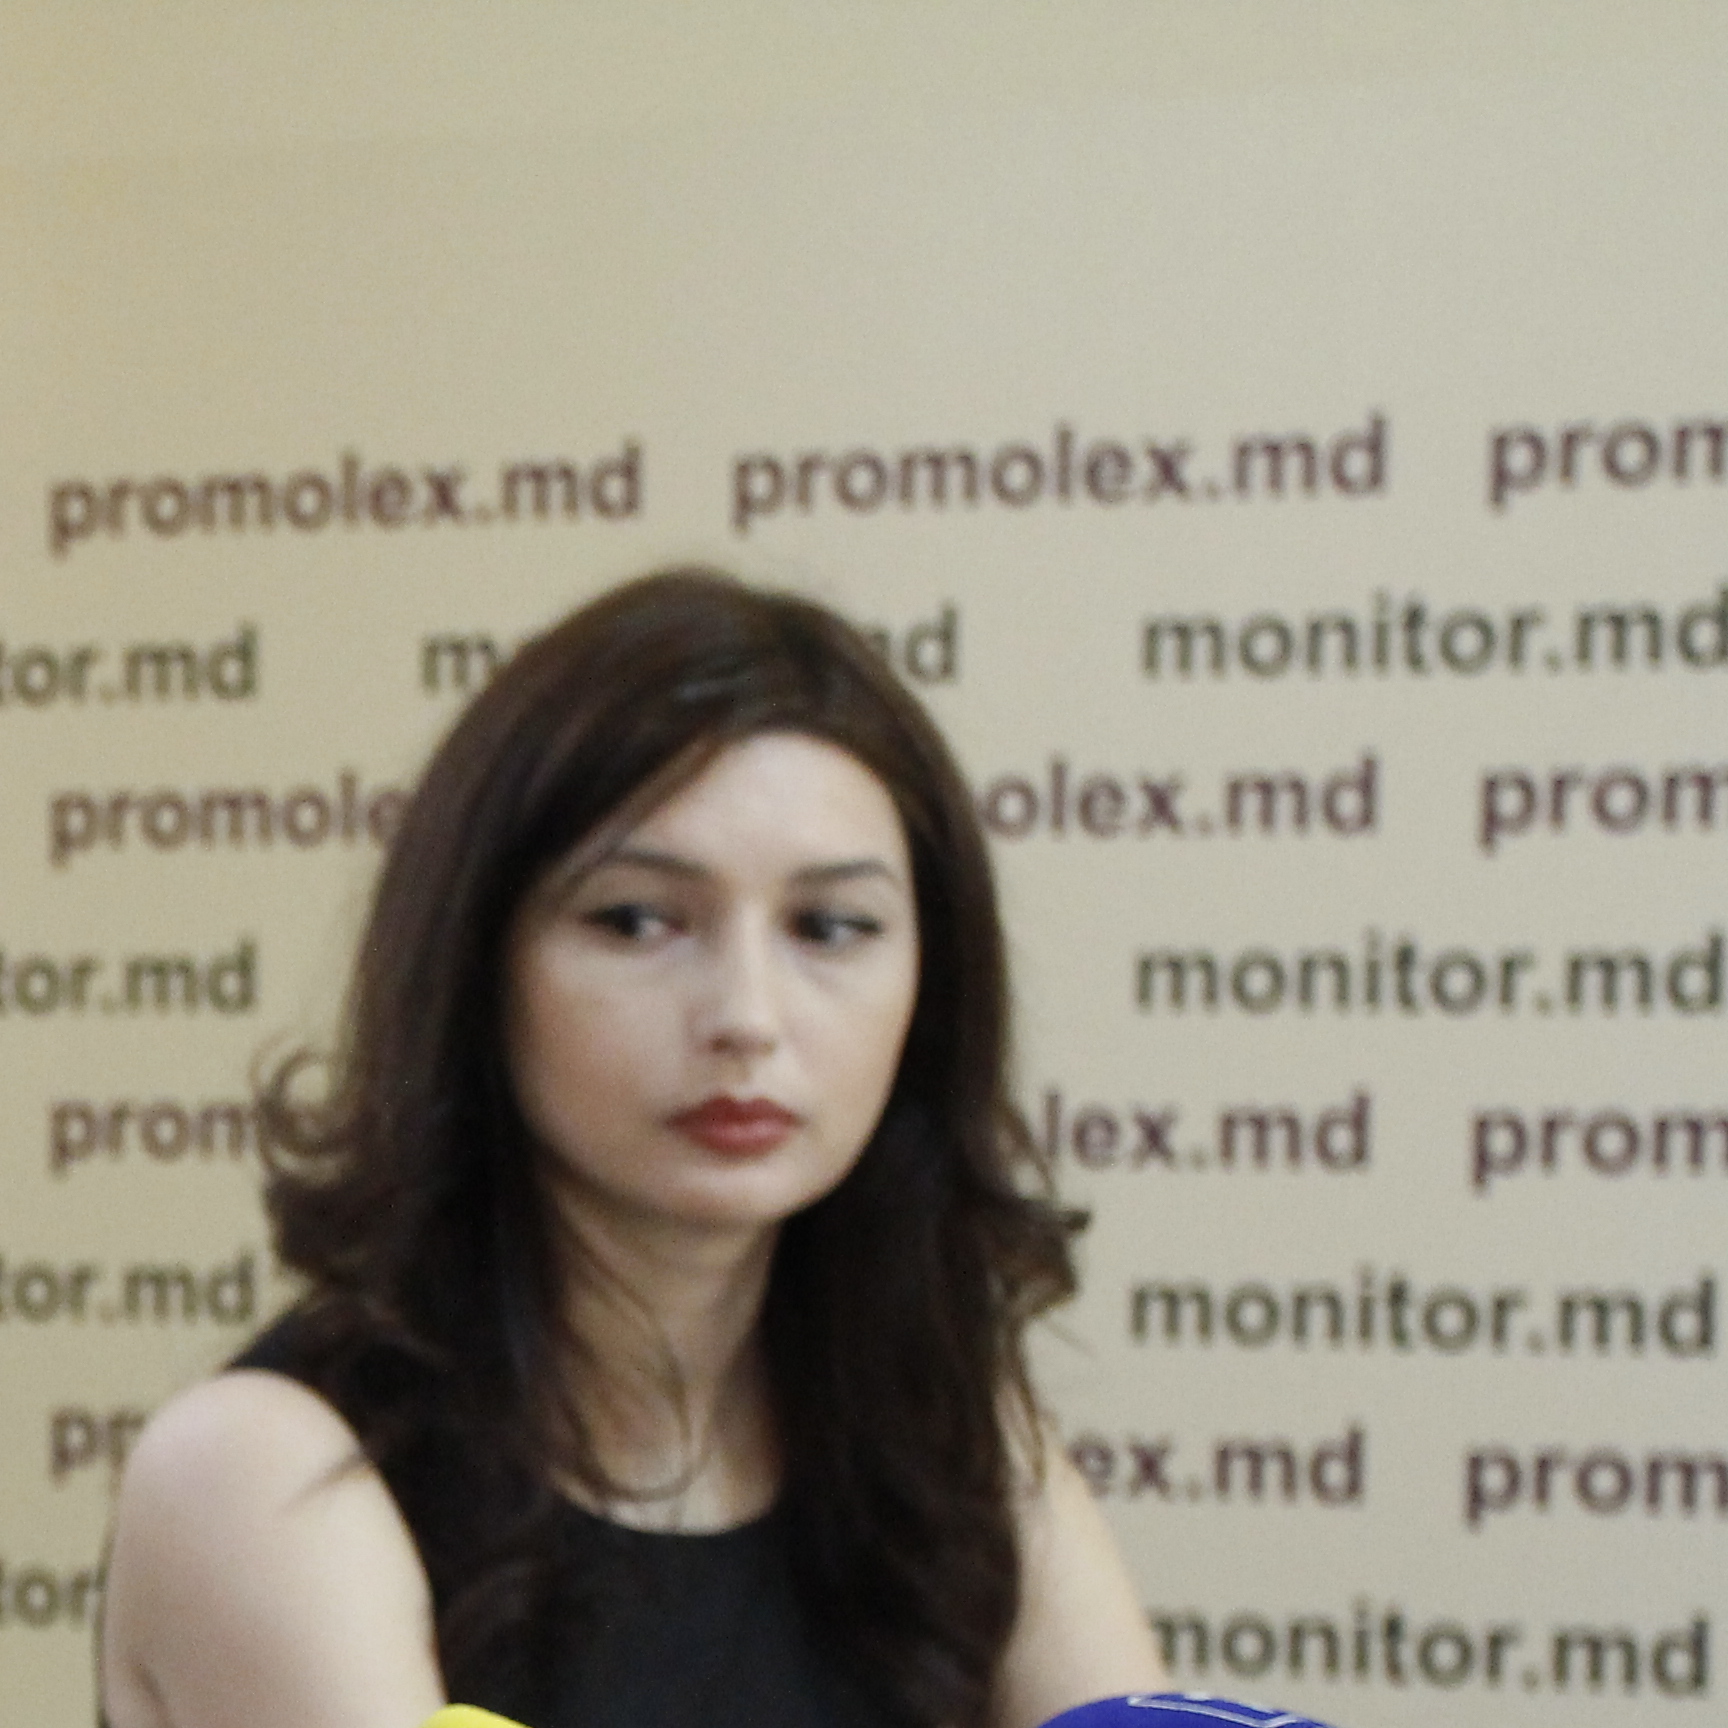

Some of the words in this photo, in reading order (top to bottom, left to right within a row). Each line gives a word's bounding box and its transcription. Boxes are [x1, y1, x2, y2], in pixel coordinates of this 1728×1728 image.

[49, 431, 642, 558] promolex.md
[732, 407, 1387, 538] promolex.md
[1142, 584, 1728, 682] monitor.md
[1134, 925, 1728, 1018] monitor.md
[1128, 1262, 1717, 1360] monitor.md
